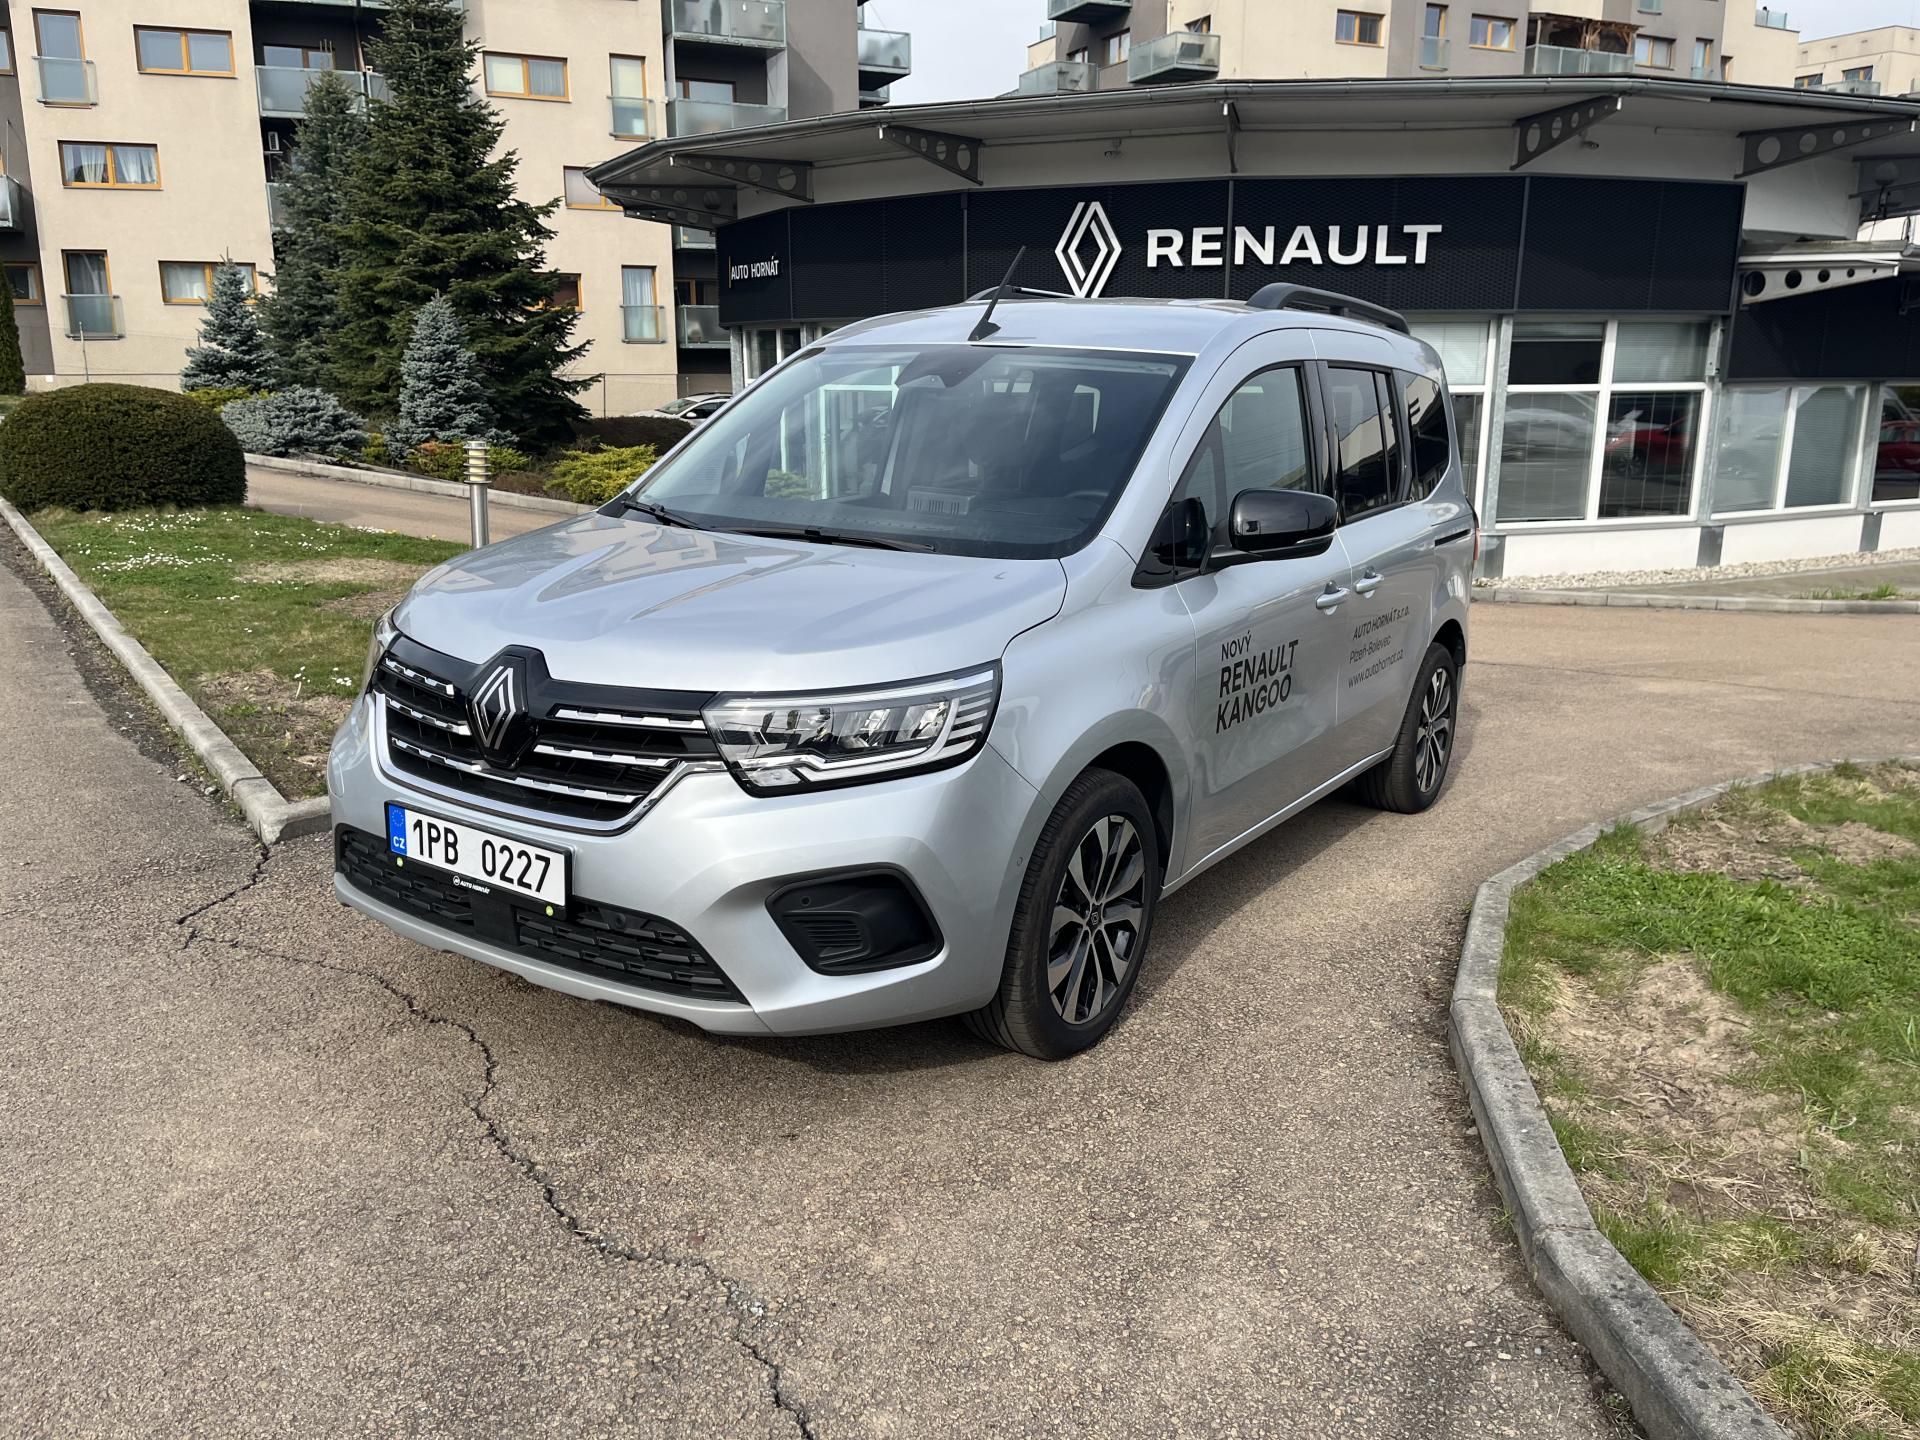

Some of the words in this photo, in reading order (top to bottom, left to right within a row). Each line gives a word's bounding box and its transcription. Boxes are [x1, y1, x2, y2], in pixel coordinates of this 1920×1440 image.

[1146, 224, 1443, 268] RENAULT
[731, 265, 749, 281] AUTO
[750, 255, 780, 278] HORNÁT
[1353, 621, 1372, 641] AUTO
[1371, 608, 1398, 632] HORNÁT
[1221, 630, 1252, 661] NOVÝ
[1219, 639, 1299, 698] RENAULT
[1216, 673, 1292, 734] KANGOO
[393, 836, 406, 849] CZ
[413, 819, 459, 866] 1PB
[481, 839, 551, 894] 0227
